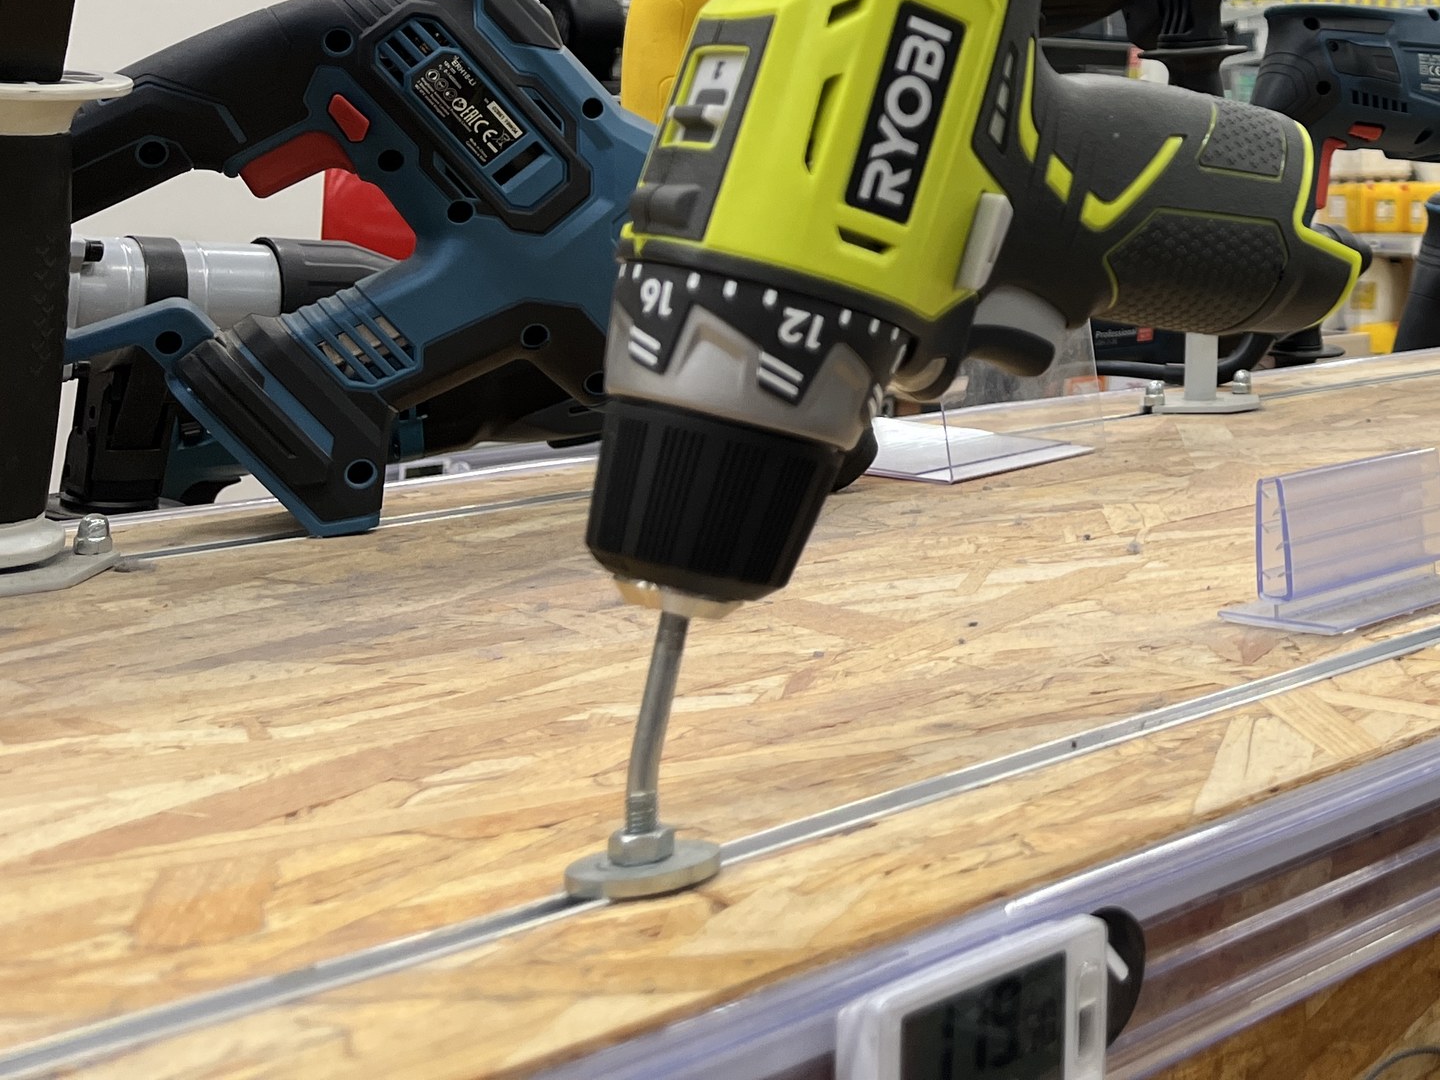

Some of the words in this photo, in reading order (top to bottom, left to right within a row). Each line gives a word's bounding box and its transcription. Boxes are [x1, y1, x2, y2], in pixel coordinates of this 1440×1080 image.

[859, 15, 953, 206] RYOBI
[640, 278, 674, 316] 16
[777, 307, 824, 350] 12
